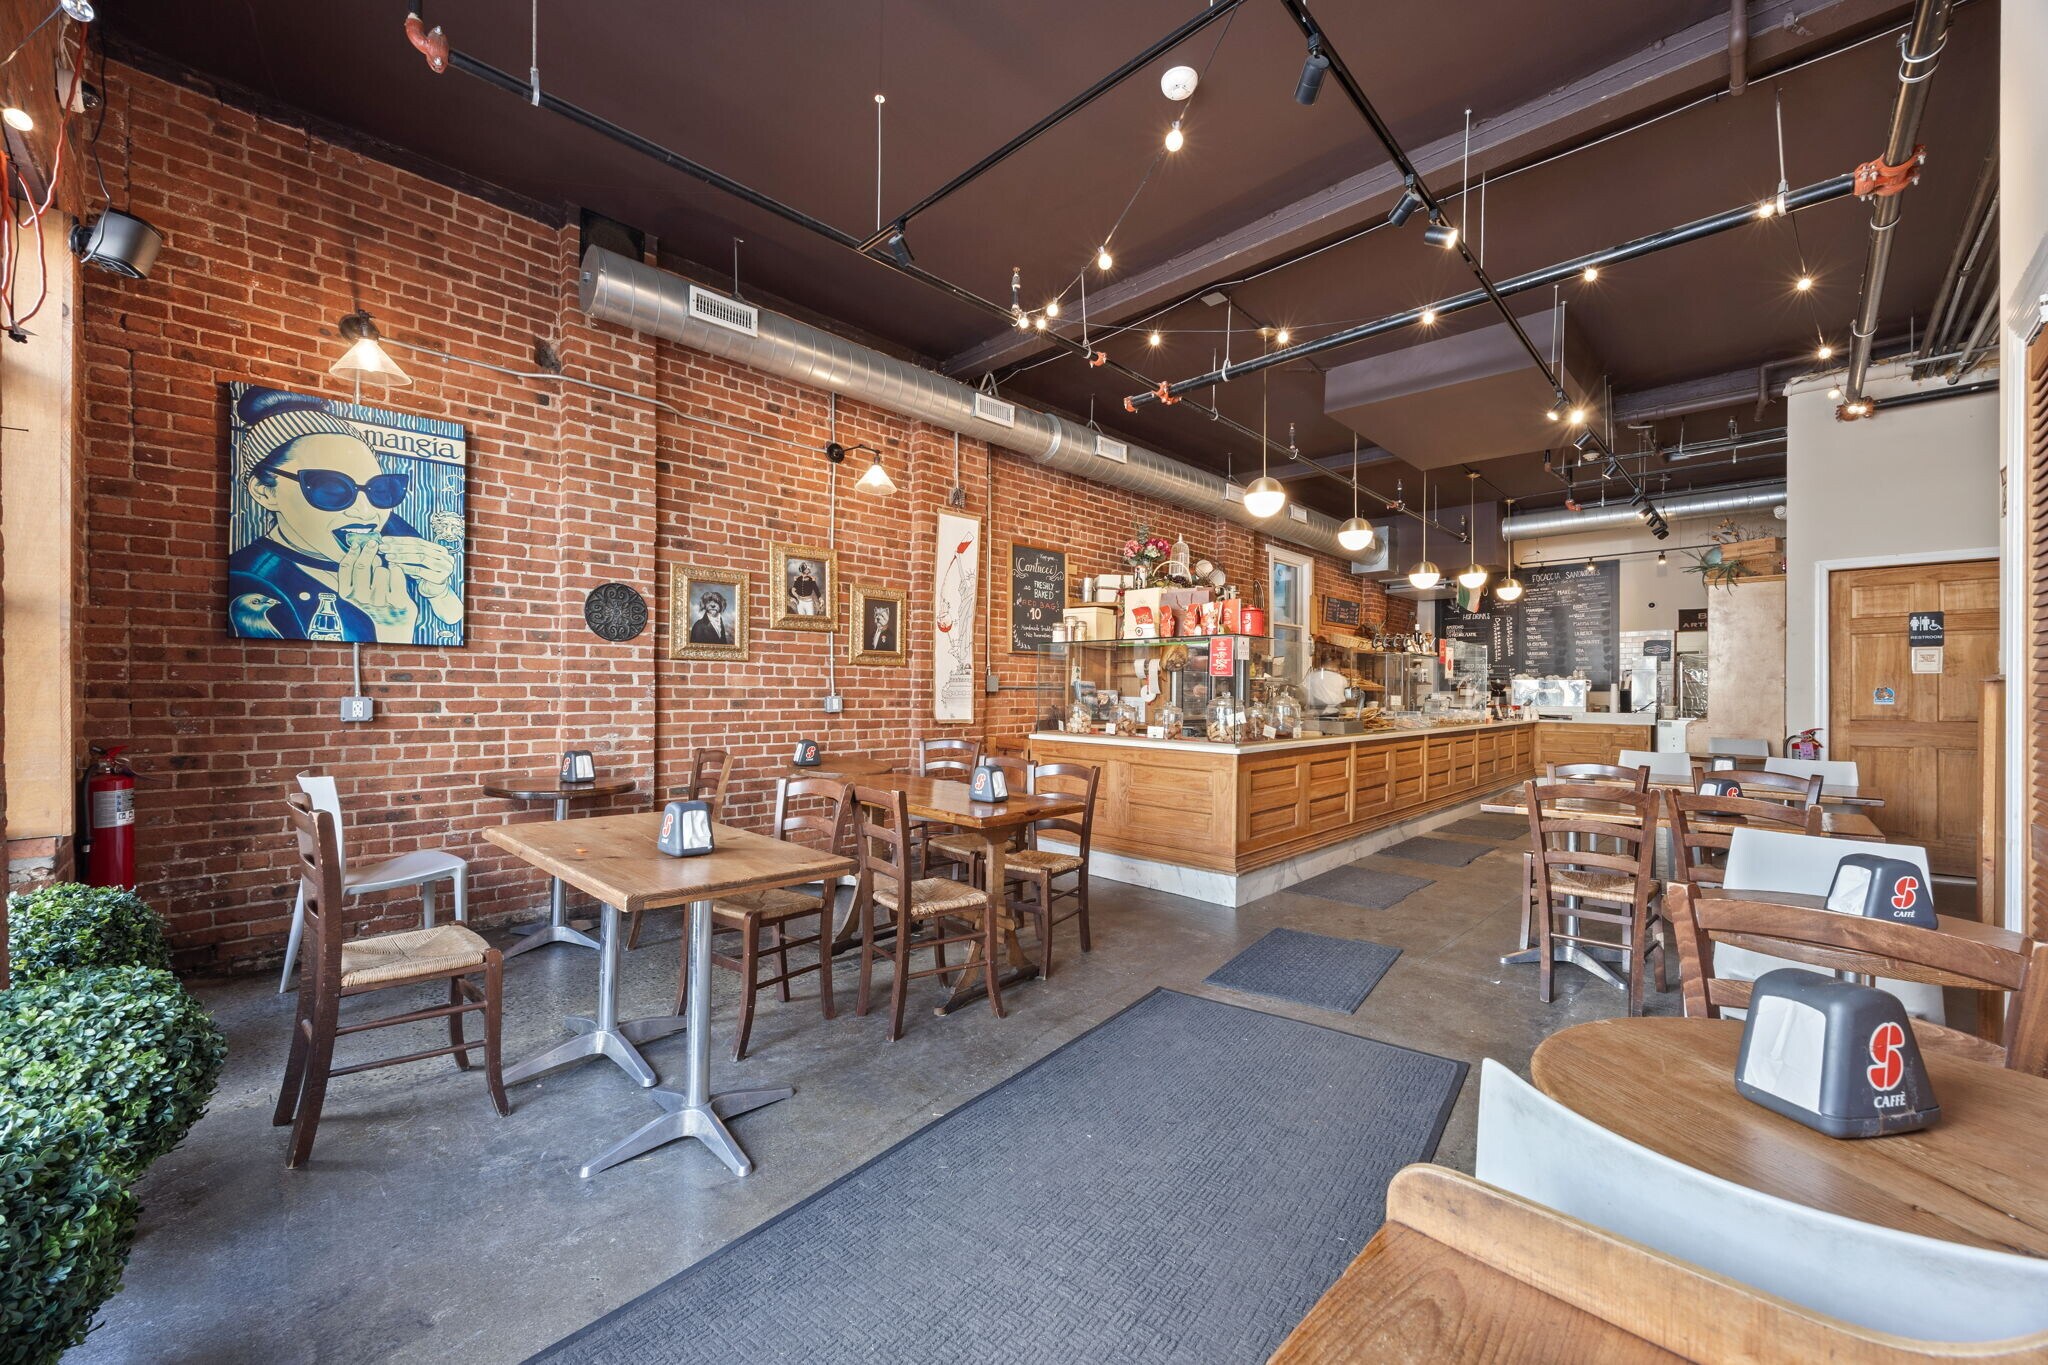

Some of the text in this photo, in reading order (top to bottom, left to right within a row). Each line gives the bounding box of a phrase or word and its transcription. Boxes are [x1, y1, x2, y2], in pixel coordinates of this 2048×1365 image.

[363, 428, 461, 459] mangia
[1034, 580, 1054, 591] FRESHLY
[1034, 588, 1054, 600] BAKED
[1040, 601, 1057, 610] BAG
[1873, 1090, 1906, 1109] CAFFÈ
